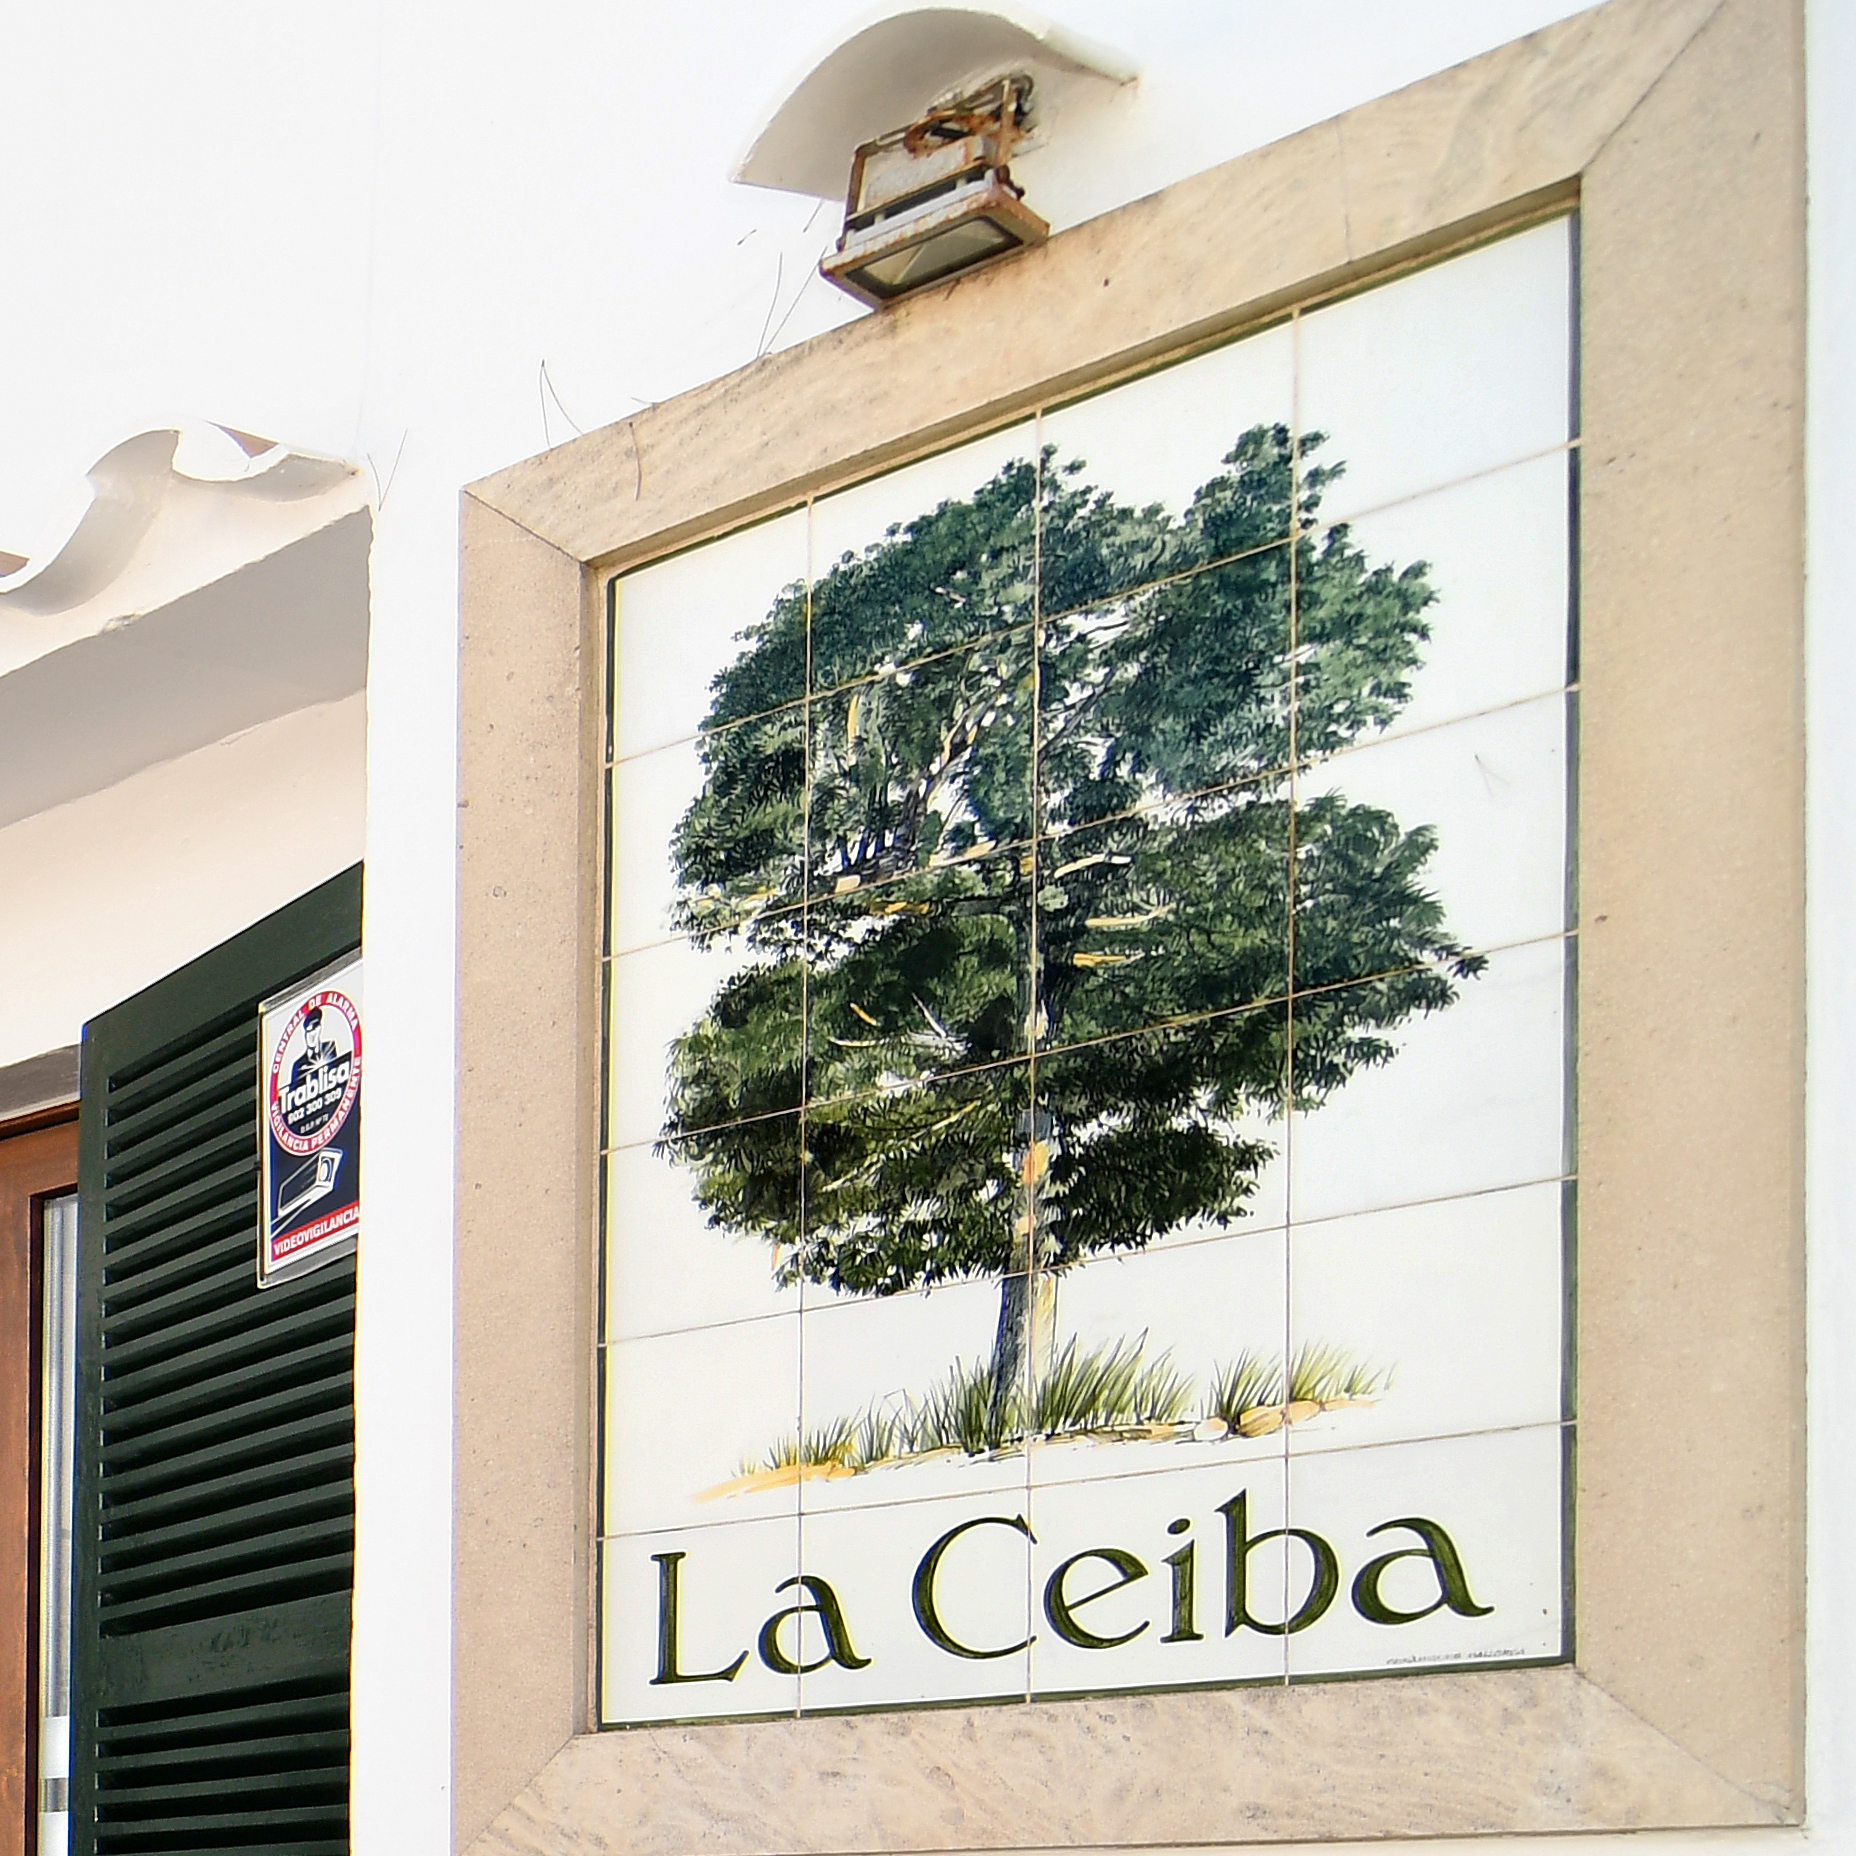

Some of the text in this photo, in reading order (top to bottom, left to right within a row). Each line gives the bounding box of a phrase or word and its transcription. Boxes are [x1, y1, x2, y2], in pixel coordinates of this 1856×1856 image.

[273, 993, 358, 1074] CENTRAL DE ALARMA
[271, 1056, 361, 1151] VIGILANCIA PERMANENTE
[279, 1061, 350, 1113] Trablisa
[274, 1206, 360, 1256] VIDEOVIGILANCIA
[650, 1489, 1494, 1685] La Ceiba
